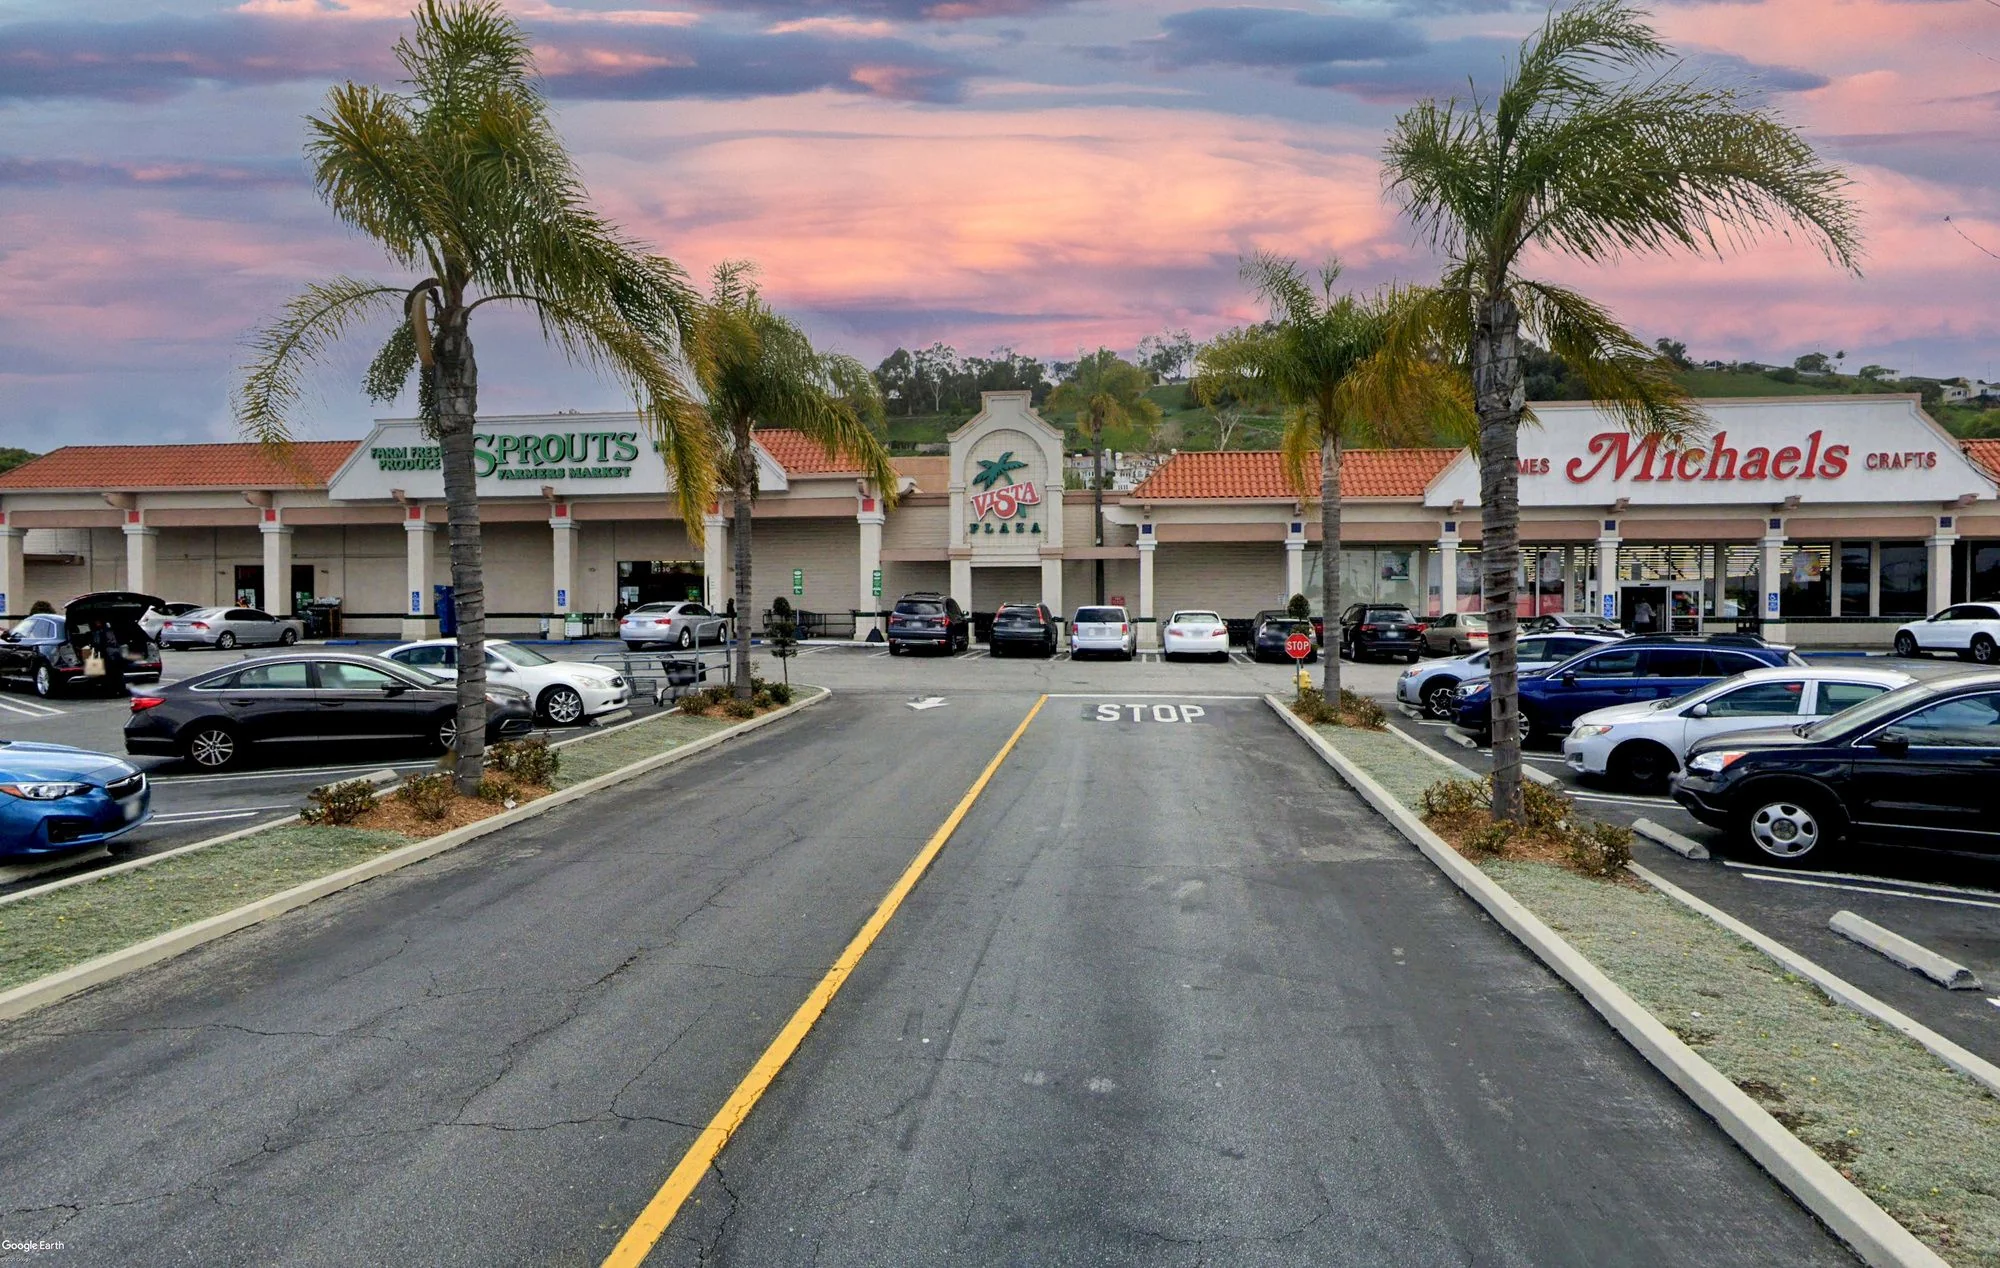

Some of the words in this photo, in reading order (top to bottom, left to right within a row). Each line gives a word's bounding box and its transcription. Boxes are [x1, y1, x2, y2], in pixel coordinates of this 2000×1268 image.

[370, 447, 407, 459] FARM
[473, 432, 638, 477] SPROUTS
[1566, 430, 1850, 484] Michaels
[1866, 451, 1937, 470] CRAFTS
[379, 459, 441, 471] PRODUCE
[498, 468, 566, 480] FARMERS
[568, 466, 631, 478] MARKET
[1515, 458, 1550, 476] MES
[970, 481, 1041, 521] VISTA
[969, 522, 1041, 534] PLAZA
[1286, 640, 1310, 651] STOP
[1096, 703, 1205, 723] STOP
